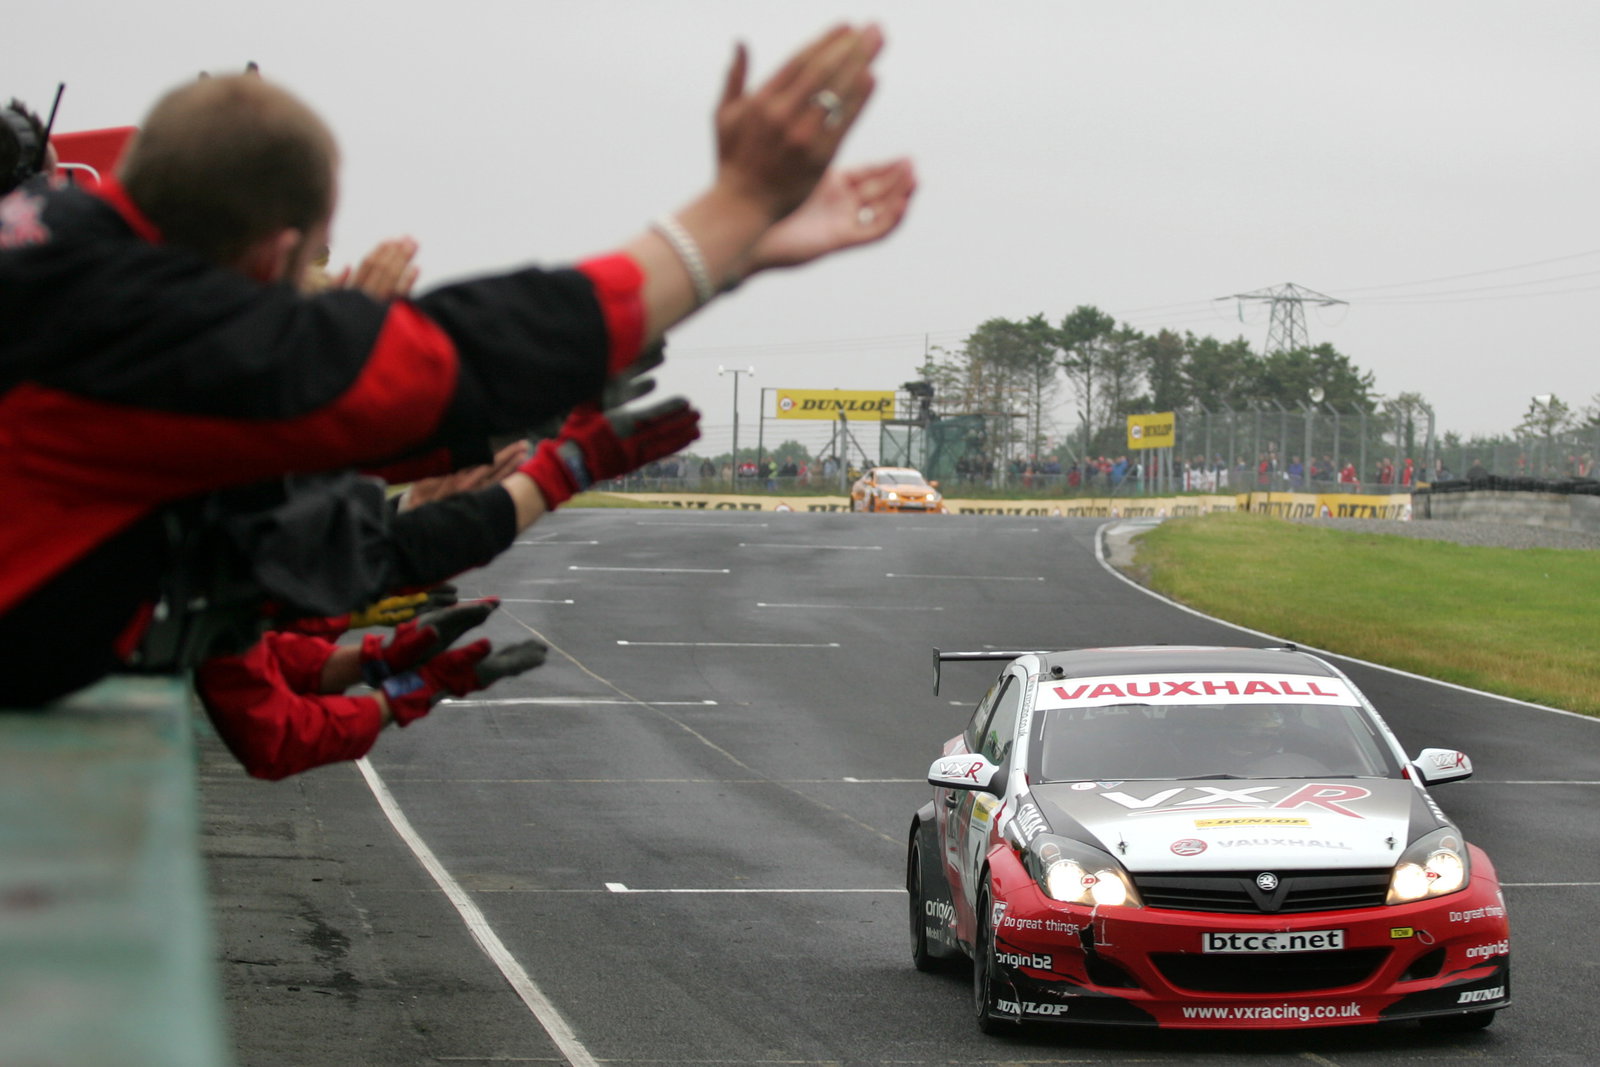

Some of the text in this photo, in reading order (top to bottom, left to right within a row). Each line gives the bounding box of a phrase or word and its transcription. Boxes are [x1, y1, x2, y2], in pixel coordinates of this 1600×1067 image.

[800, 398, 891, 412] DUNLOP
[1053, 680, 1338, 700] VAUXHALL
[1428, 752, 1467, 770] VXR
[940, 761, 984, 783] VXR
[1099, 783, 1372, 820] VXR
[1217, 838, 1353, 851] VAUXHALL
[1449, 911, 1462, 922] Do
[1463, 907, 1485, 923] great
[1004, 916, 1079, 936] Do great things
[1209, 930, 1339, 950] btcc.net
[1466, 943, 1497, 959] origin
[995, 952, 1052, 970] origin b2
[997, 999, 1069, 1016] DUNLOP
[1182, 1001, 1361, 1021] www.vxracing.co.uk
